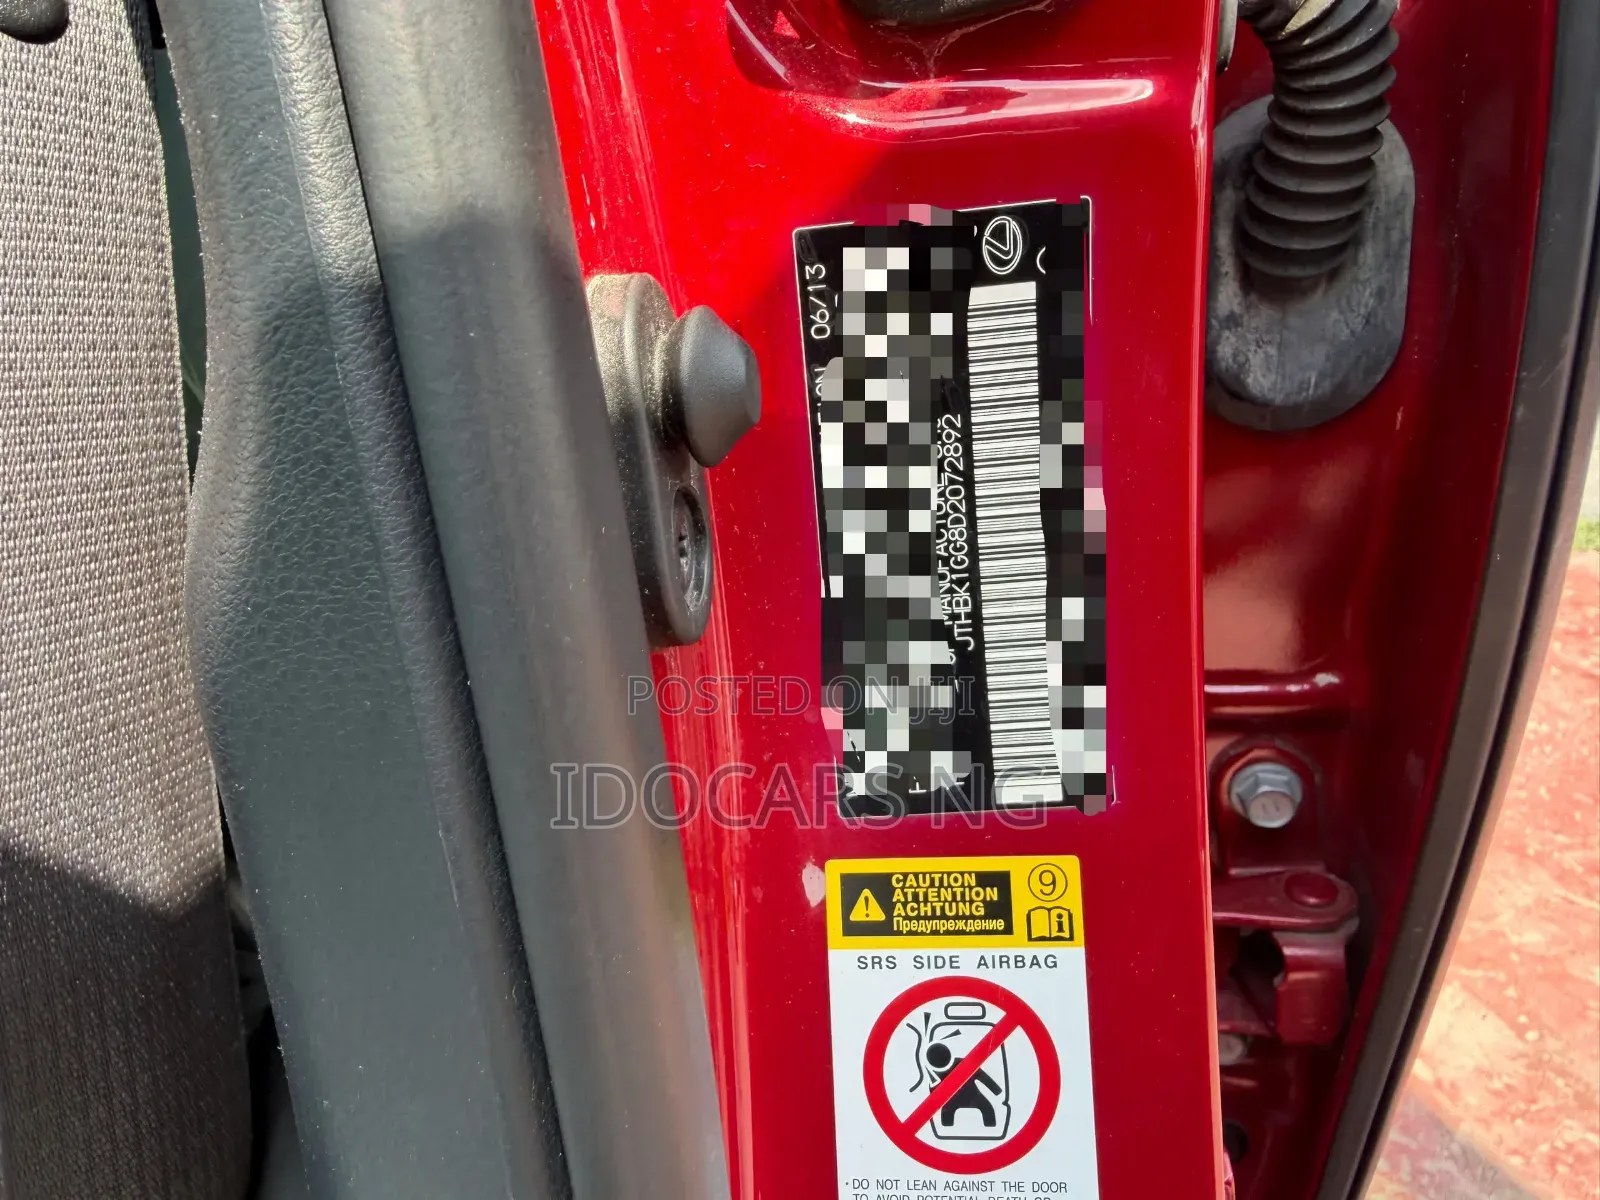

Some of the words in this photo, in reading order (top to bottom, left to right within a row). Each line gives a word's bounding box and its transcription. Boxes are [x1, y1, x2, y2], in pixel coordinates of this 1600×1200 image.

[805, 263, 831, 340] 06/13
[942, 413, 975, 651] JTHBK1GG8D2072892
[891, 873, 976, 888] CAUTION
[892, 887, 998, 902] ATTENTION
[893, 902, 985, 917] ACHTUNG
[893, 917, 1005, 934] Предупреждение
[857, 955, 897, 970] SRS
[913, 955, 961, 969] SIDE
[976, 954, 1058, 969] AIRBAG
[852, 1178, 869, 1190] DO
[876, 1179, 900, 1190] NOT
[906, 1179, 937, 1191] LEAN
[943, 1180, 995, 1192] AGAINST
[1001, 1181, 1025, 1192] THE
[1032, 1181, 1068, 1193] DOOR
